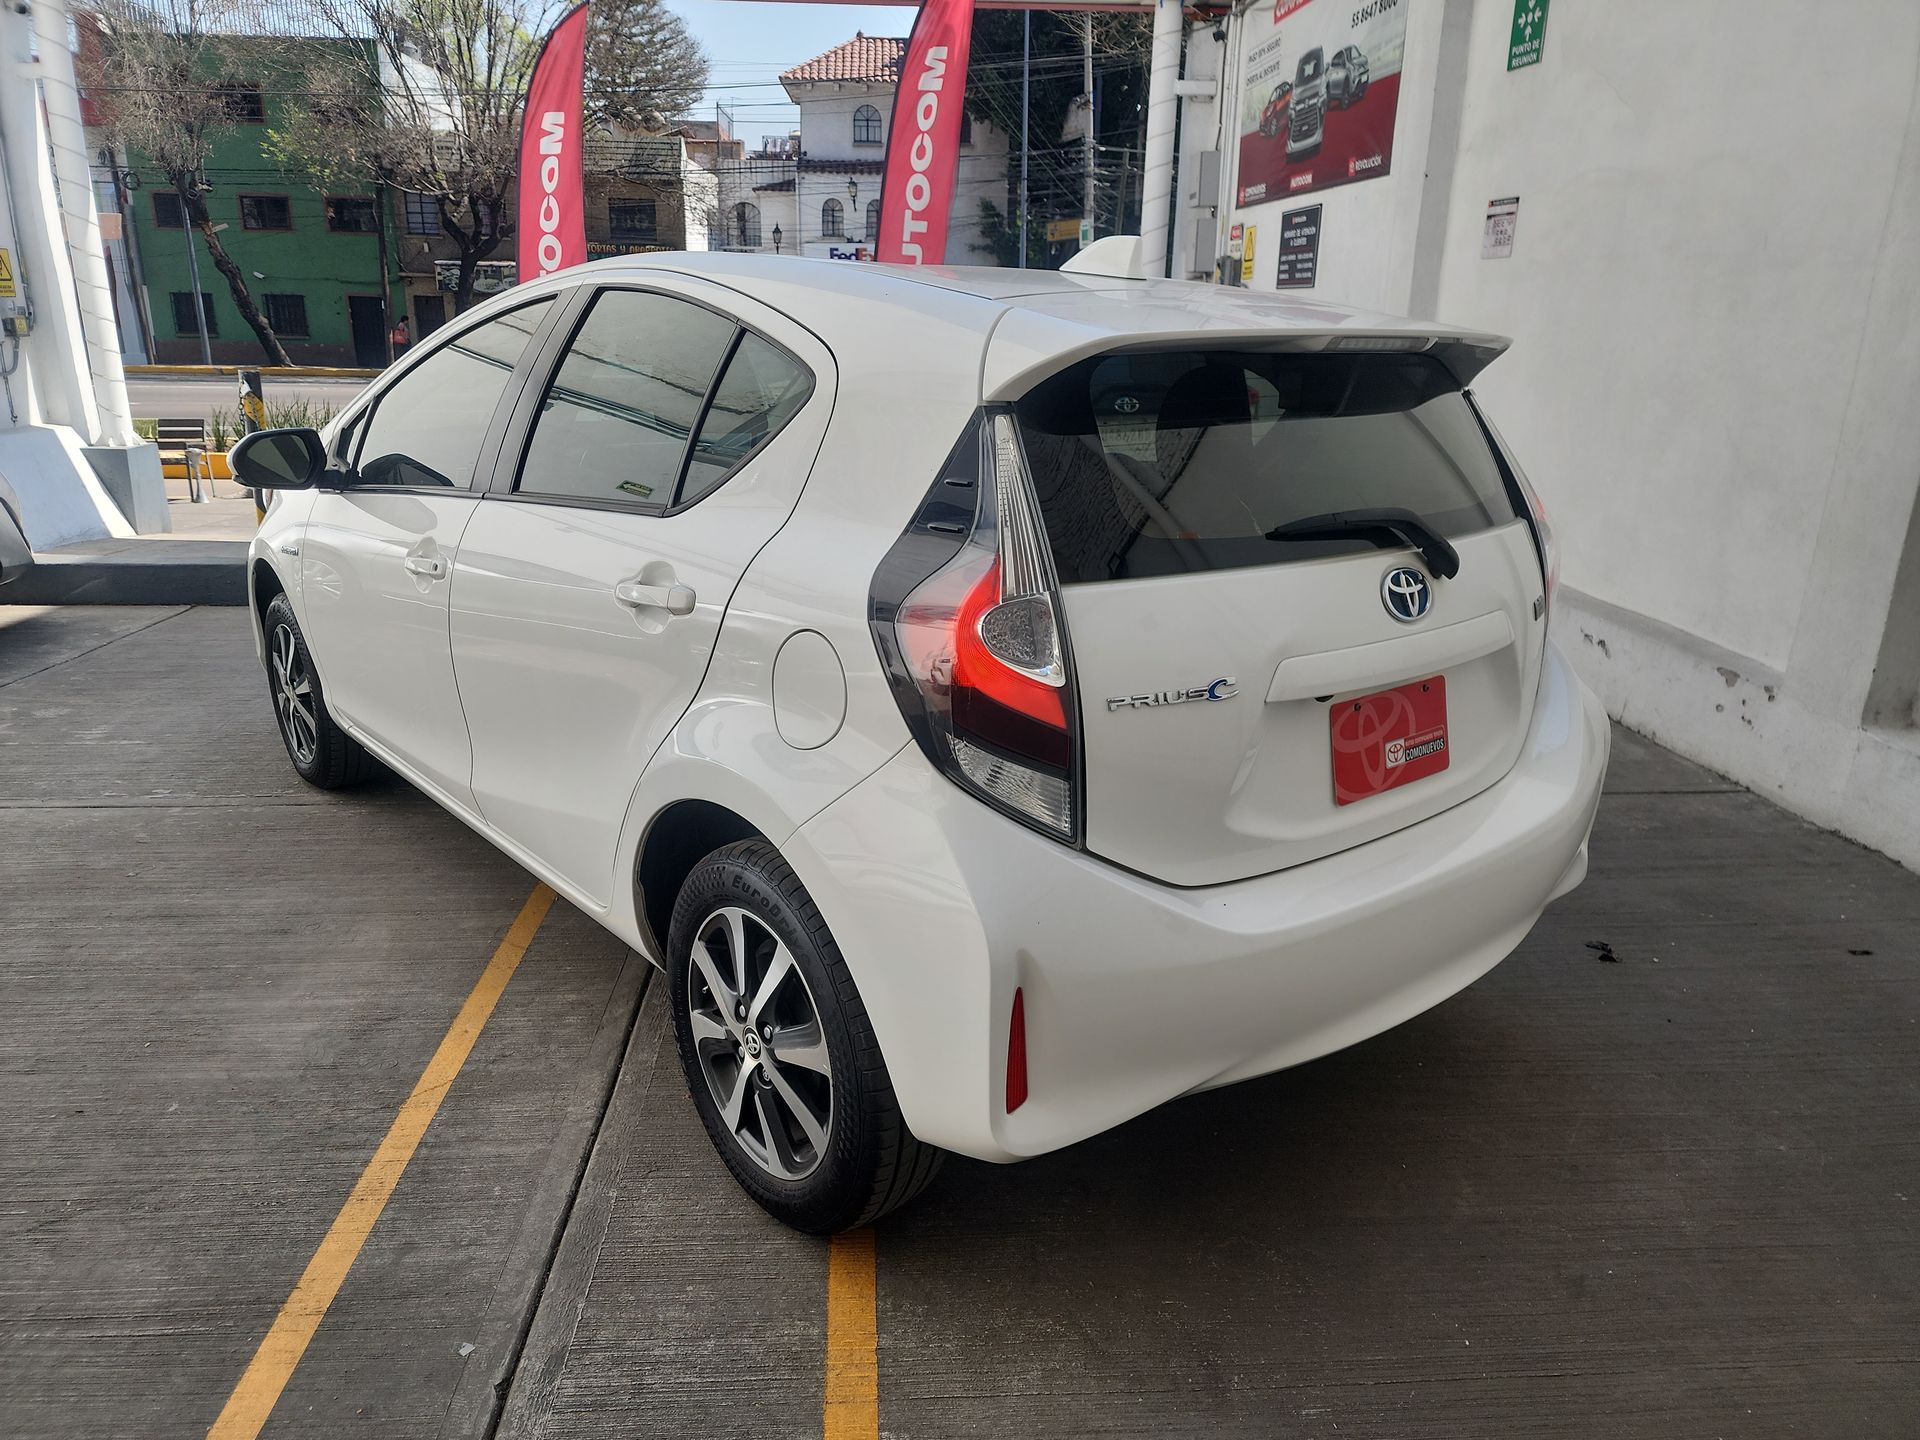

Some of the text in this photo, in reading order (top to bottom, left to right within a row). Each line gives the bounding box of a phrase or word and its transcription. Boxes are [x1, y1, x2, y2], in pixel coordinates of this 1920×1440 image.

[1512, 39, 1541, 56] PUNTO DE
[902, 46, 948, 265] UTOCOM
[587, 243, 616, 253] TORTAS
[1406, 738, 1444, 760] COMONUEVOS
